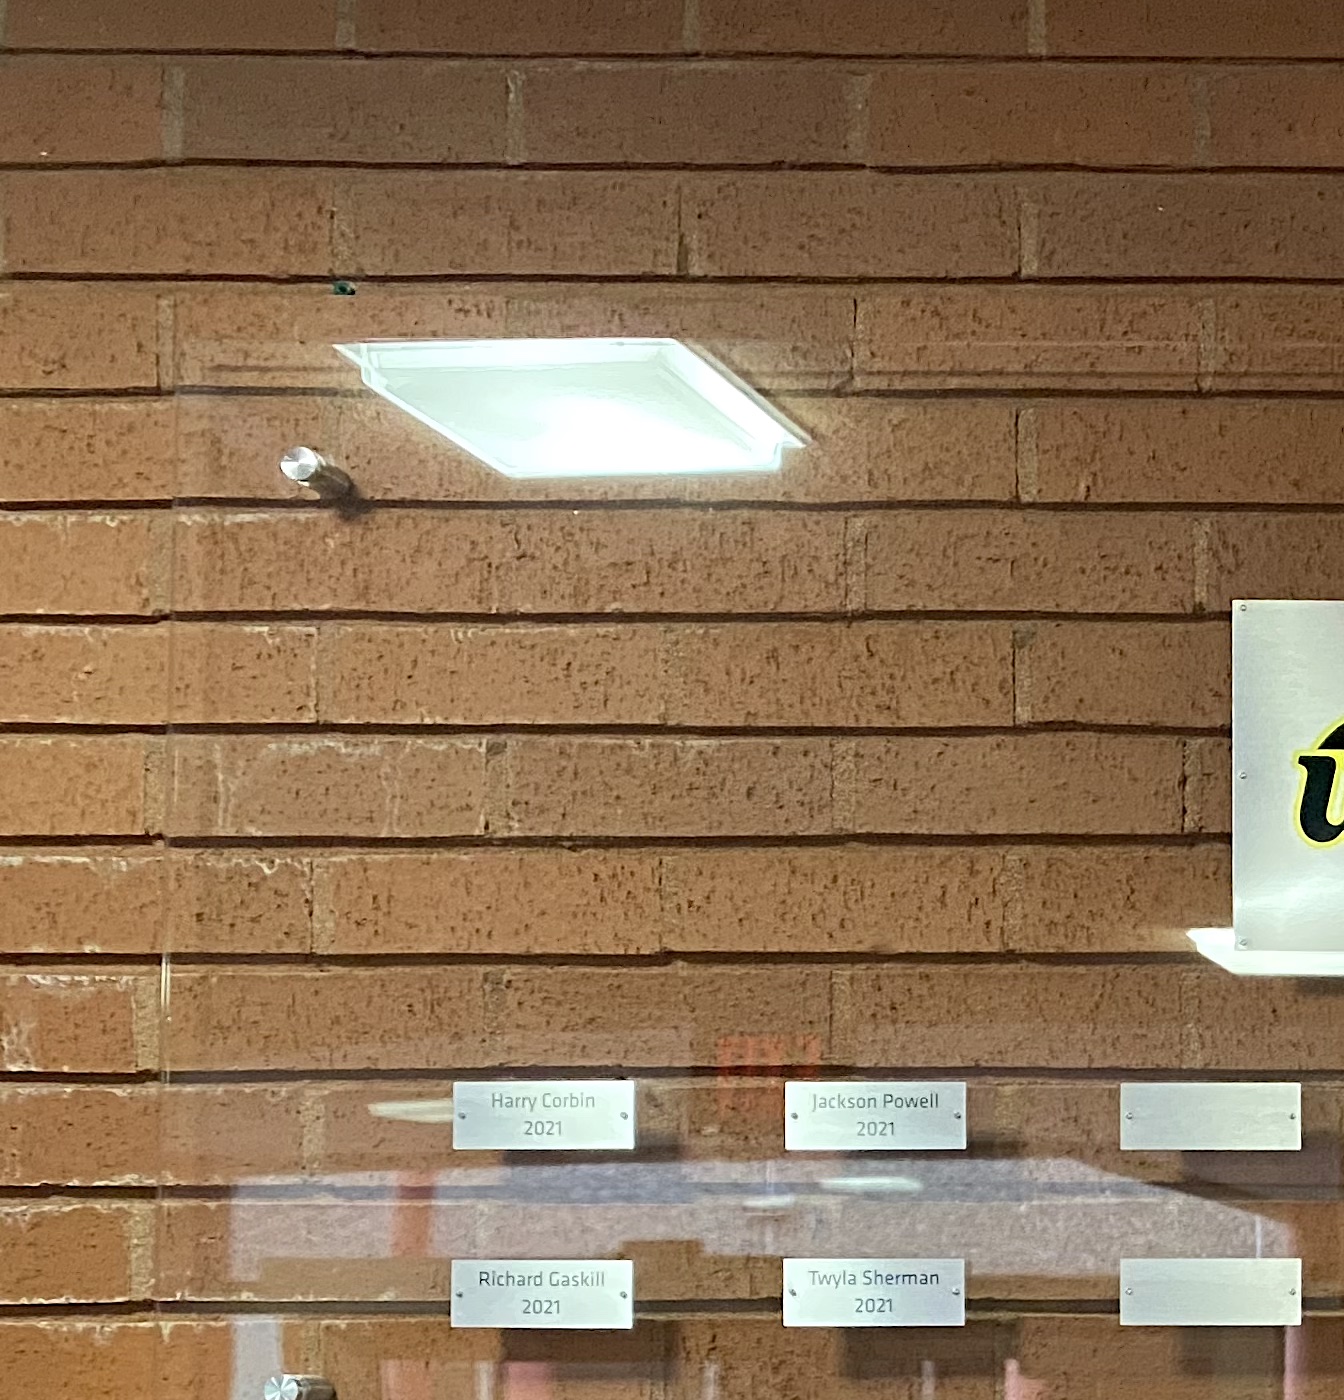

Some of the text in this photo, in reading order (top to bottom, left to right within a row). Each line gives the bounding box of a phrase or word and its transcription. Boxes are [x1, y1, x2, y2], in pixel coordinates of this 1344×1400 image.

[491, 1092, 596, 1112] Harry Corbin
[812, 1092, 939, 1113] Jackson Powell
[523, 1120, 562, 1136] 2021
[856, 1121, 895, 1137] 2021
[479, 1270, 605, 1287] Richard Gaskill
[807, 1269, 940, 1290] Twyla Sherman
[521, 1298, 560, 1315] 2021
[855, 1297, 893, 1313] 2021
